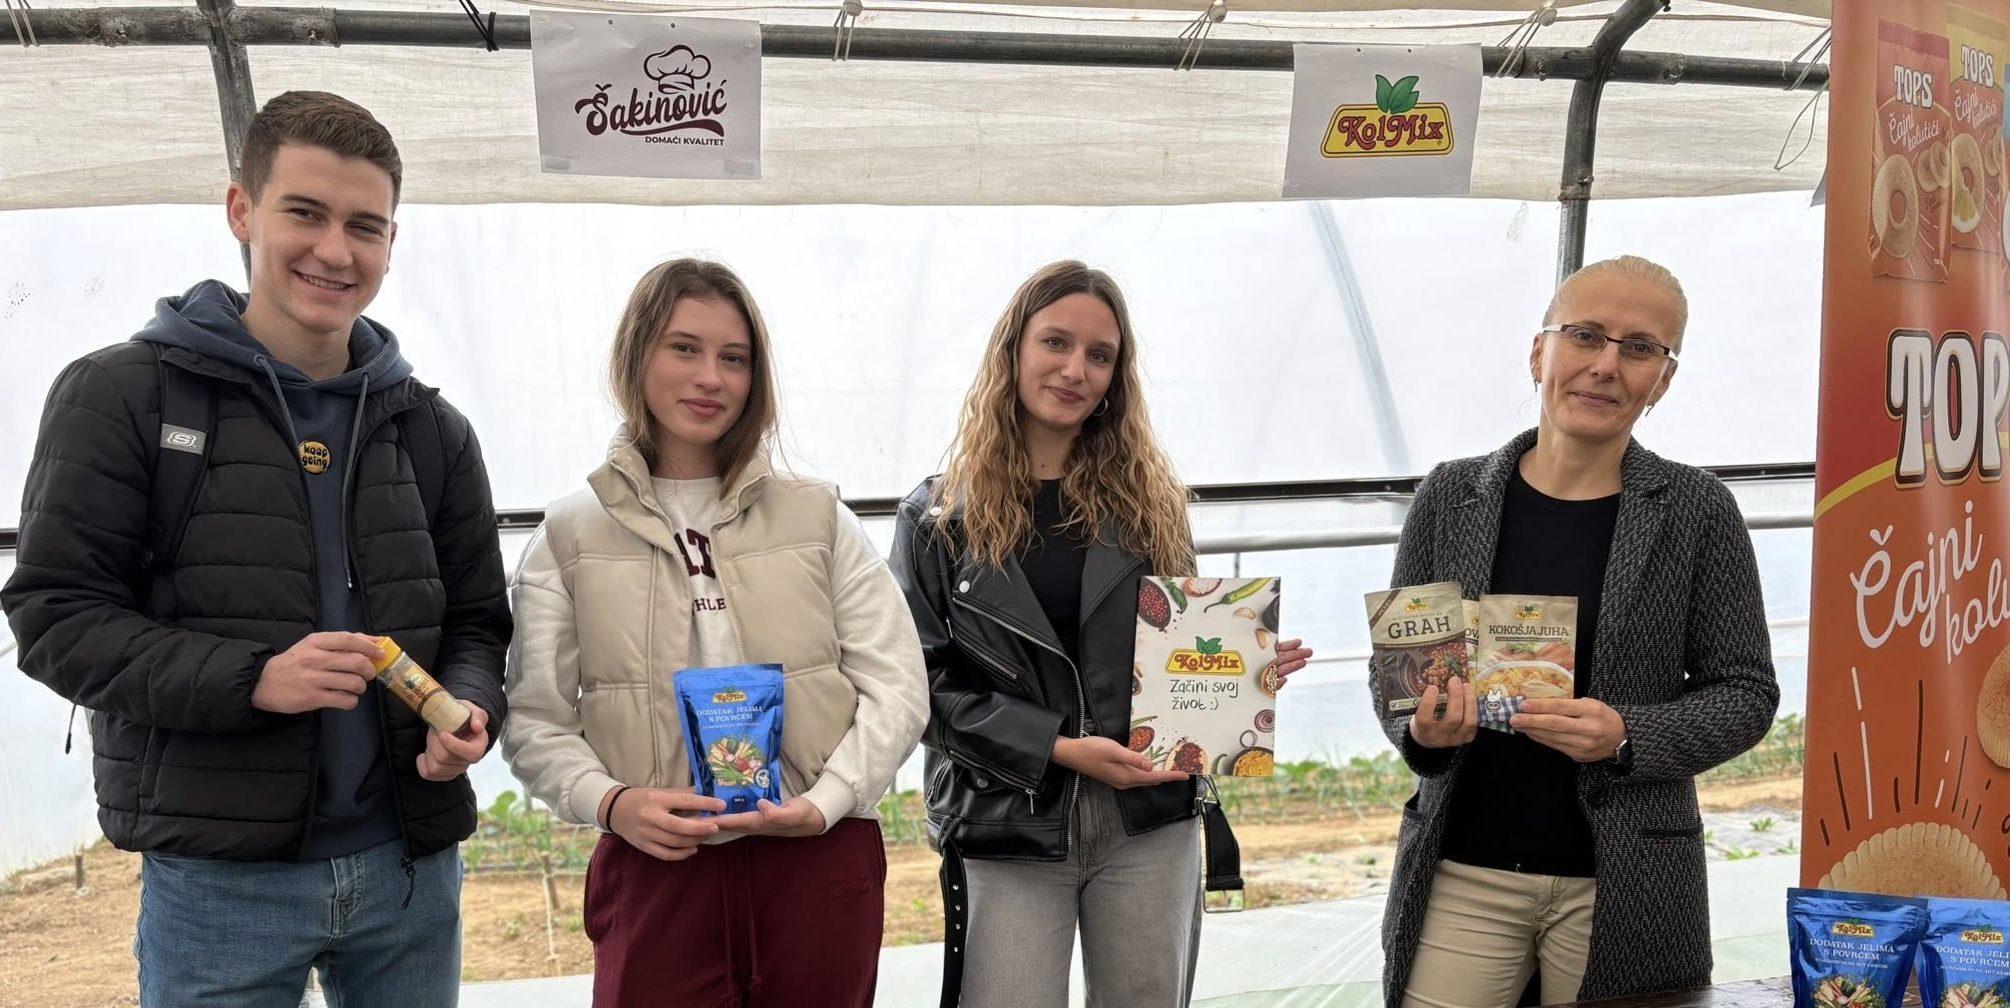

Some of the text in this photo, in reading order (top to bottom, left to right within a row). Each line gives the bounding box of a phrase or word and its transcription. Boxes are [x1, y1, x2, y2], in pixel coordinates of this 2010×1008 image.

[1961, 43, 1995, 88] TOPS
[1893, 64, 1933, 109] TOPS
[575, 80, 727, 136] Šakinović
[1337, 113, 1445, 151] KolMix
[1889, 107, 1915, 146] Čajni
[645, 135, 725, 146] DOMAĆI KVALITET
[1850, 500, 1983, 649] Čajni
[1387, 615, 1452, 639] GRAH
[1489, 623, 1569, 636] KOKOŠJA JUHA
[1174, 654, 1240, 672] KolMix
[1169, 679, 1239, 699] Začini svoj
[1171, 695, 1207, 711] život
[1809, 938, 1895, 953] DODATAK JELIMA
[1823, 947, 1830, 956] S
[1936, 945, 1984, 956] DODATAK
[1950, 955, 1957, 963] S
